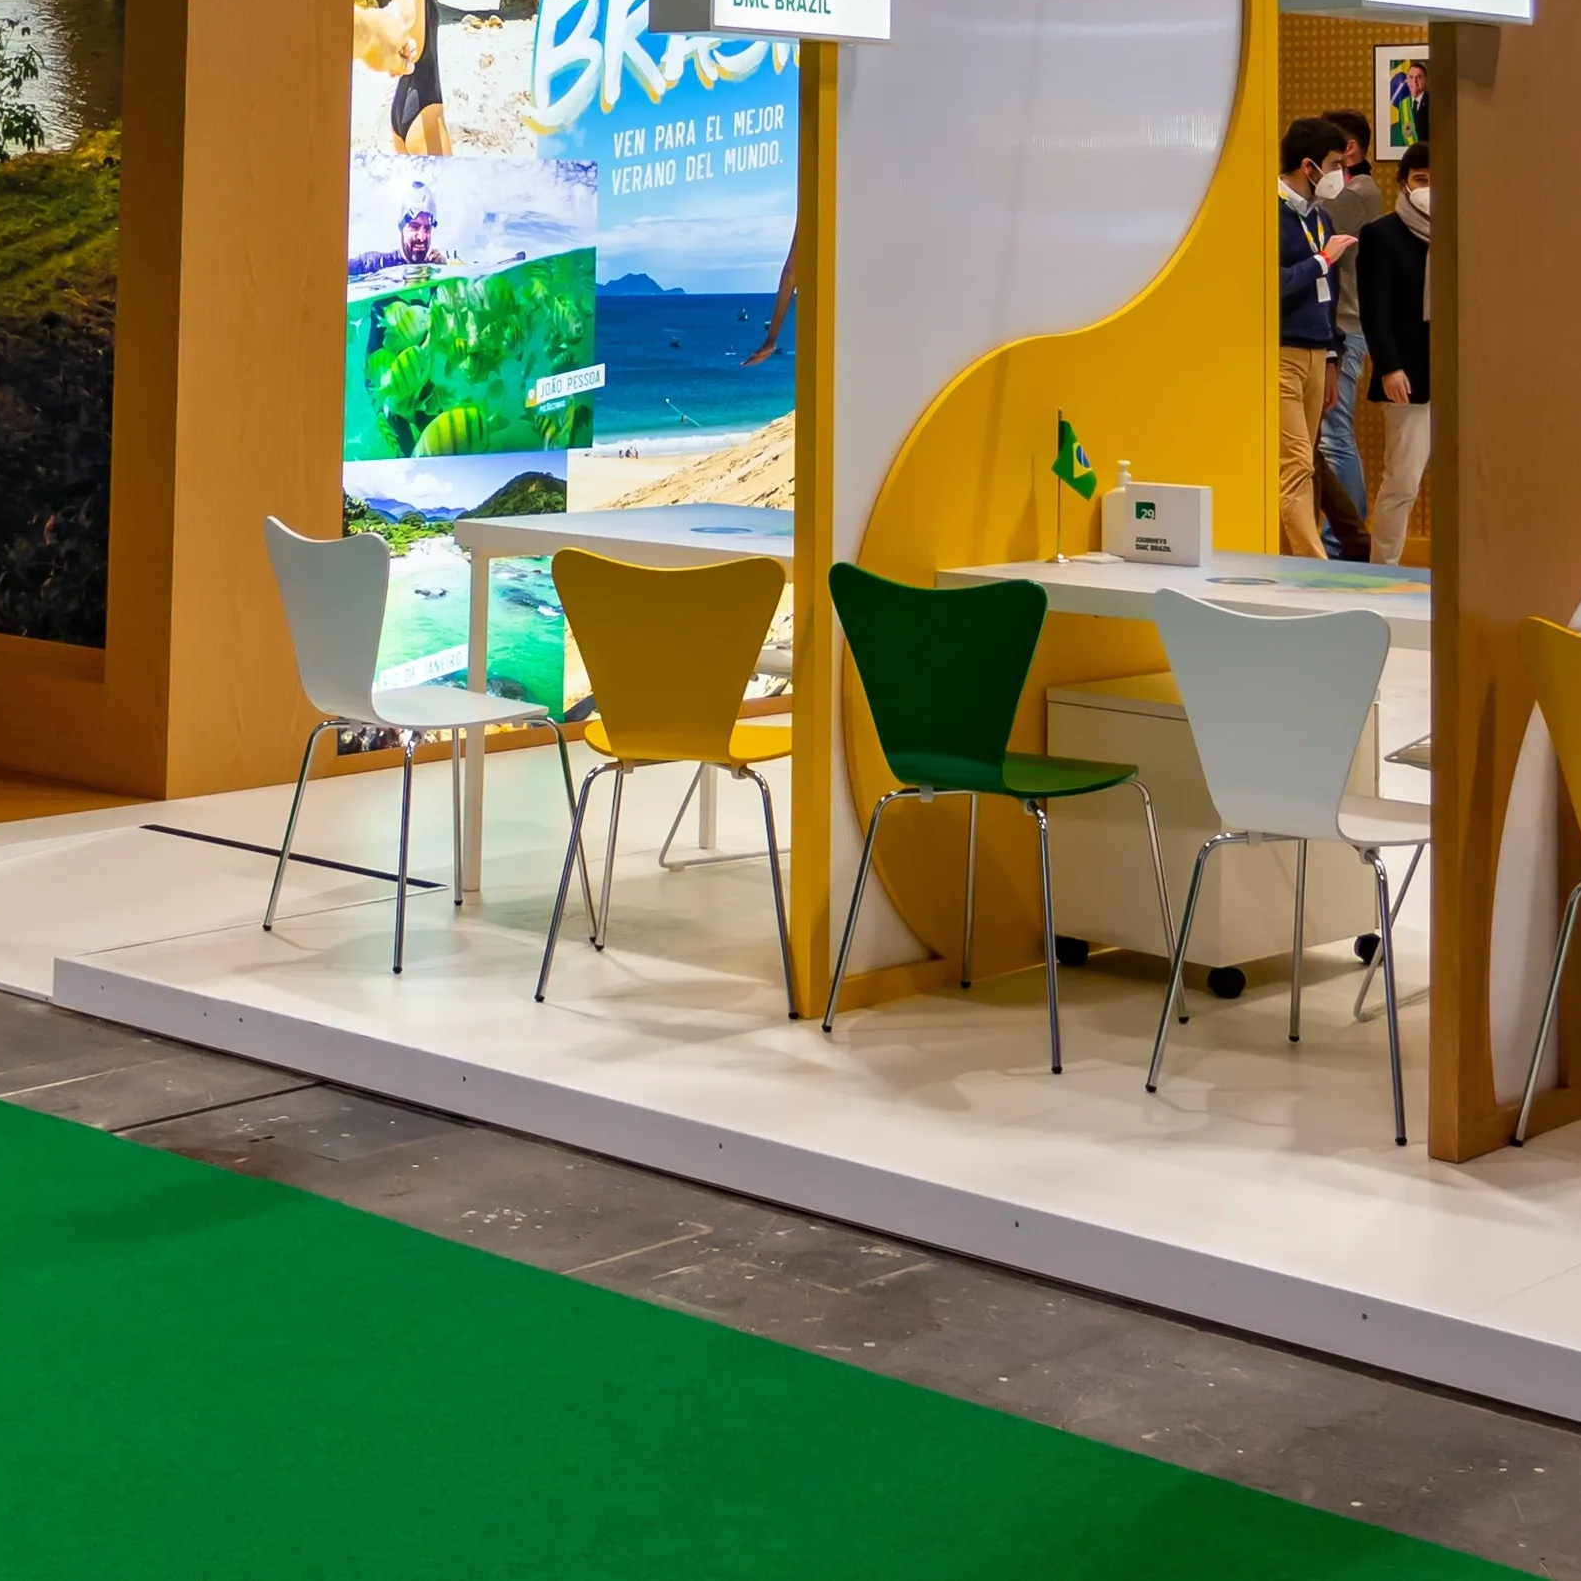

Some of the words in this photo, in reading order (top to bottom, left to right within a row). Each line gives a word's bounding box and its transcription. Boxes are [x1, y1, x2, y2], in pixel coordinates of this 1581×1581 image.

[613, 128, 646, 160] VEN
[654, 119, 696, 152] PARA
[706, 115, 724, 143] EL
[733, 104, 785, 138] MEJOR
[611, 159, 677, 196] VERANO
[685, 152, 715, 182] DEL
[724, 140, 784, 175] MUNDO.
[539, 377, 563, 398] JOÃO
[567, 370, 601, 392] PESSOA
